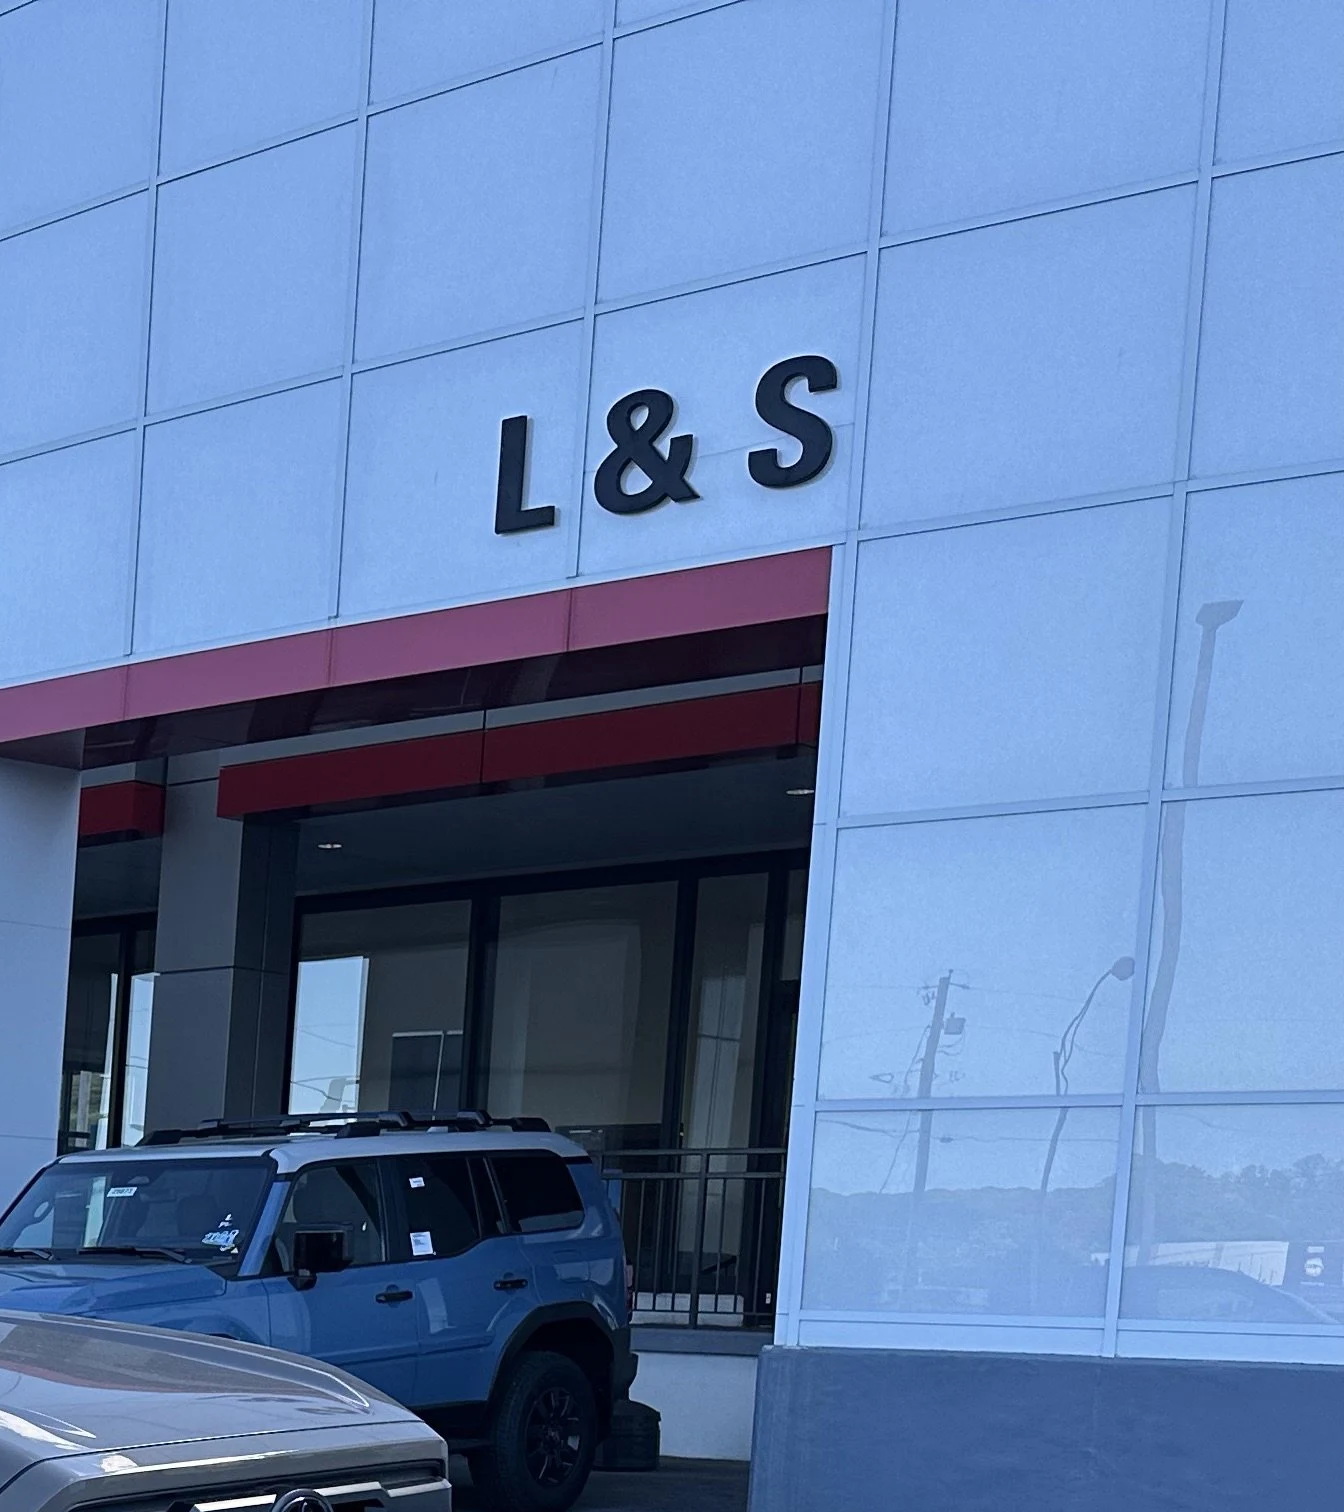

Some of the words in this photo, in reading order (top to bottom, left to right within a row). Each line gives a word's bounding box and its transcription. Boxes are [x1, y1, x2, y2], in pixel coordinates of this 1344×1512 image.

[494, 414, 557, 535] L
[593, 388, 701, 515] &
[747, 354, 839, 489] S
